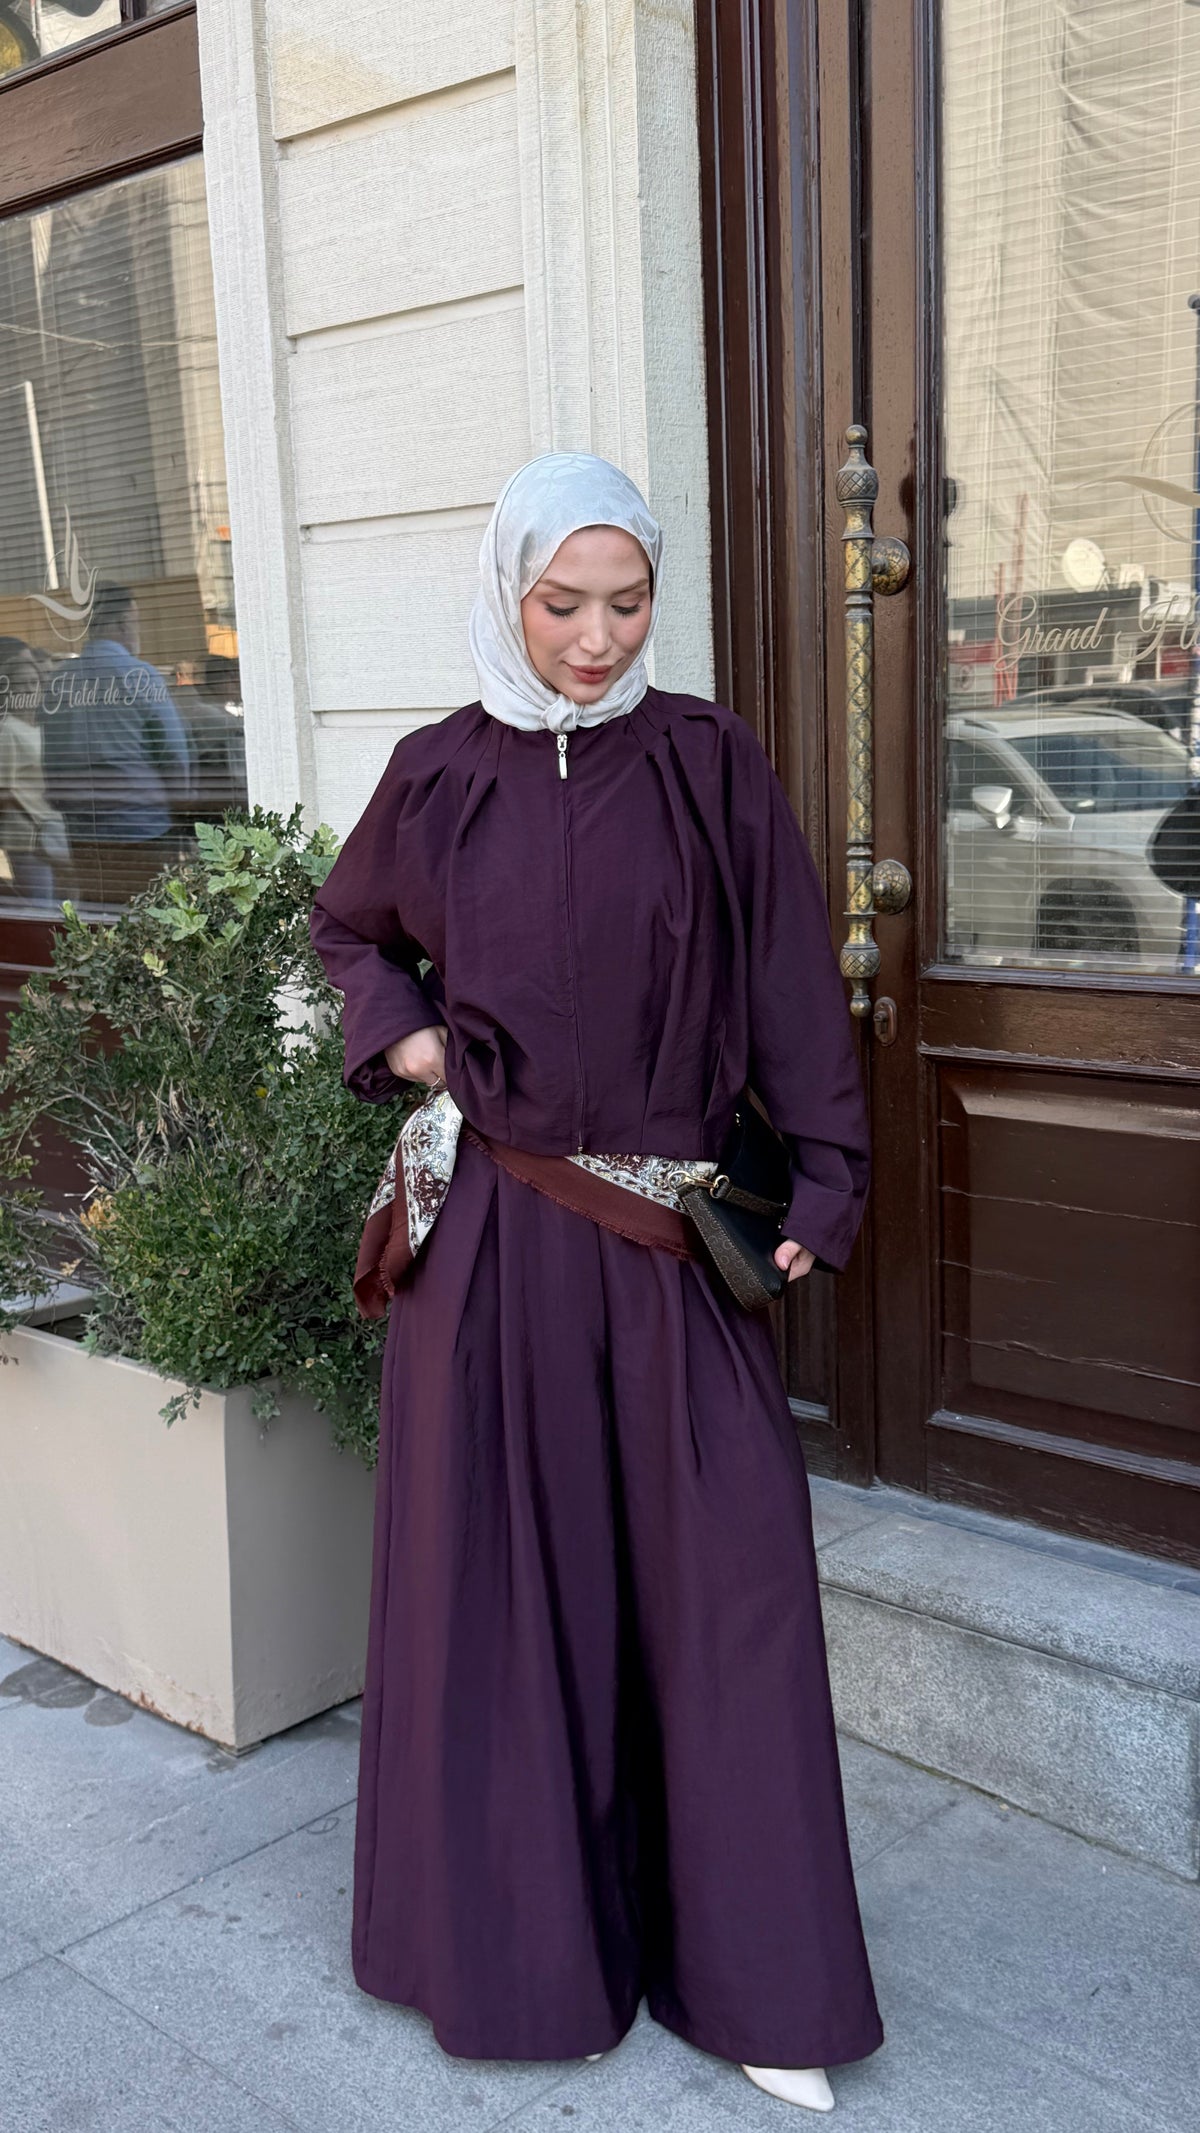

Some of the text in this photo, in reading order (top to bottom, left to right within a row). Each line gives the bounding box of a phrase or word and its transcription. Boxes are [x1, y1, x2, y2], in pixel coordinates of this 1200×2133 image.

[994, 595, 1108, 671] Grand
[42, 672, 100, 714] Hotel
[103, 676, 120, 705] de
